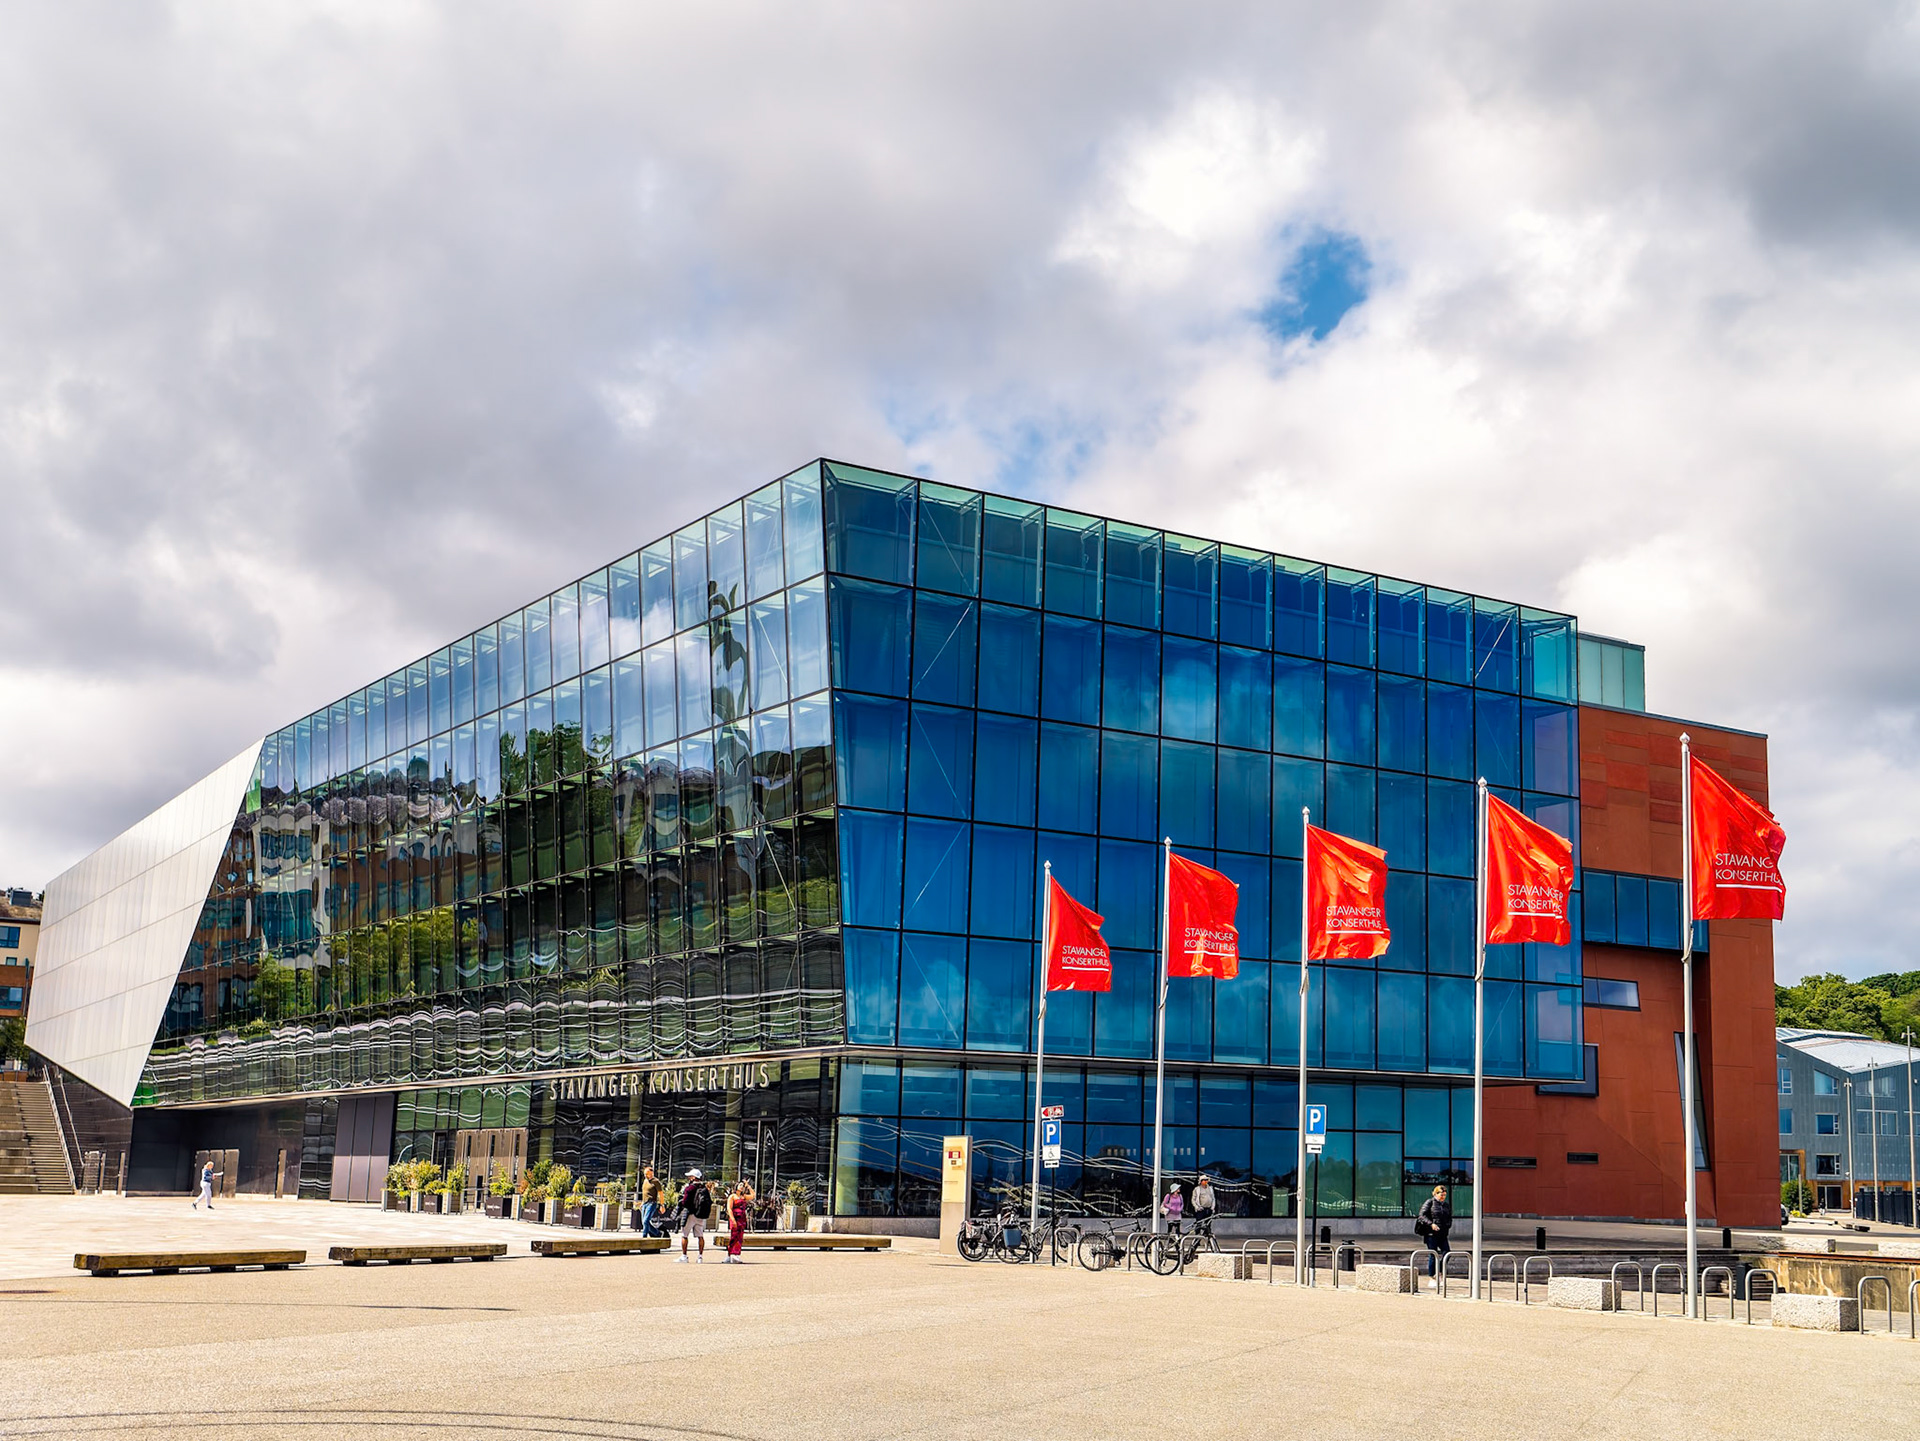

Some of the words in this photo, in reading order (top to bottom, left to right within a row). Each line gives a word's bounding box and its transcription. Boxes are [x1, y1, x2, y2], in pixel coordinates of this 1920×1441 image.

[1715, 853, 1774, 869] STAVANG
[1715, 869, 1783, 886] KONSERTHU
[1508, 884, 1563, 903] STAVANGER
[1326, 905, 1381, 918] STAVANGER
[1185, 927, 1234, 942] STAVANGER
[1184, 939, 1236, 952] KONSERTHUS
[549, 1072, 639, 1101] STAVANGER
[648, 1063, 770, 1095] KONSERTHUS
[1310, 1108, 1321, 1131] P
[1046, 1123, 1057, 1144] P
